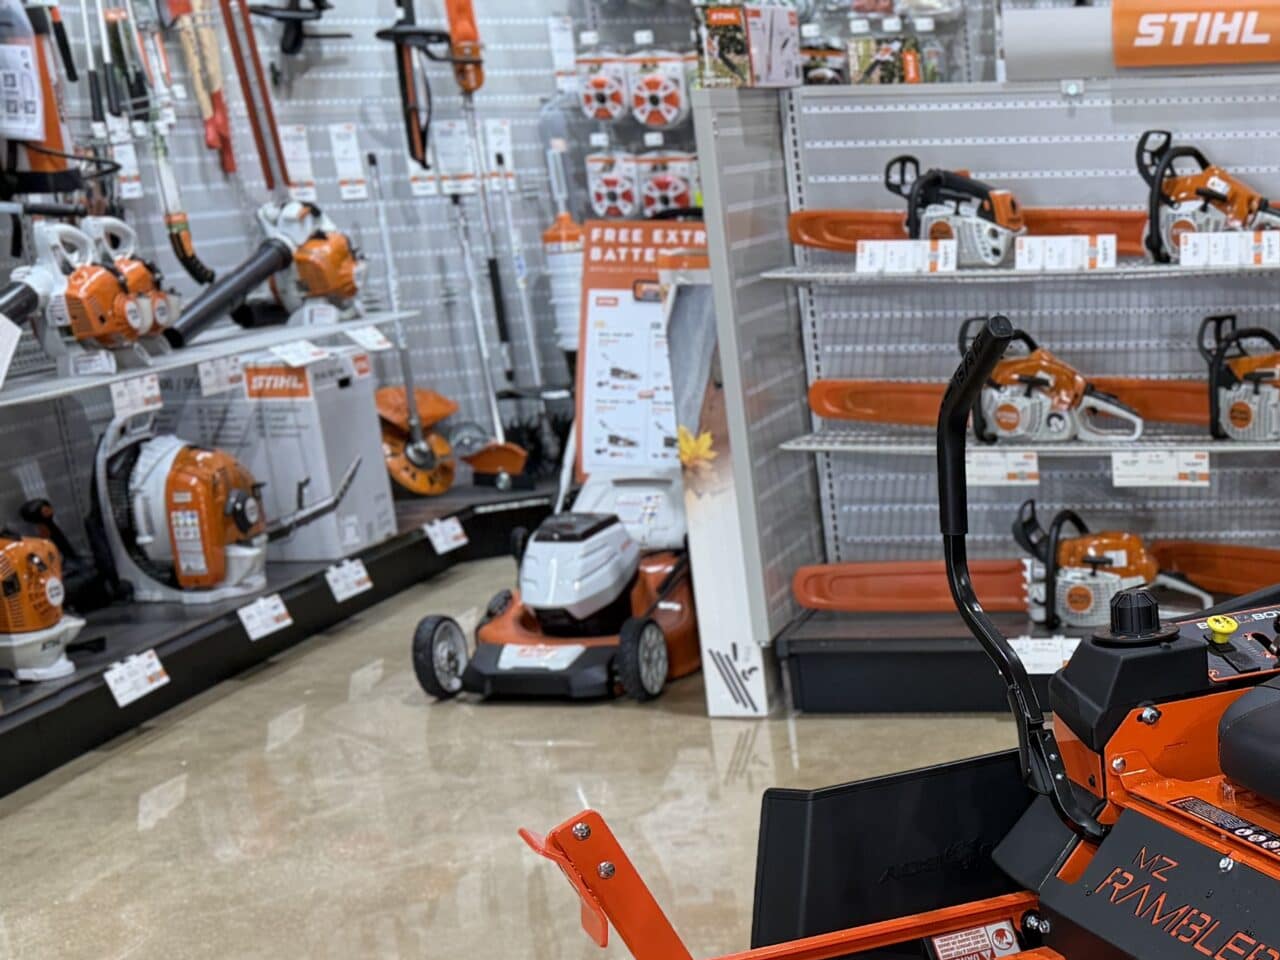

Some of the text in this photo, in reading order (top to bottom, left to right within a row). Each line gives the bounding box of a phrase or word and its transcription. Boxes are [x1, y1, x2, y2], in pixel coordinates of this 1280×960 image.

[1133, 11, 1271, 47] STIHL
[591, 227, 706, 244] FREE EXTR
[590, 247, 655, 262] BATTE
[251, 375, 304, 390] STIHL
[1132, 846, 1180, 882] MZ
